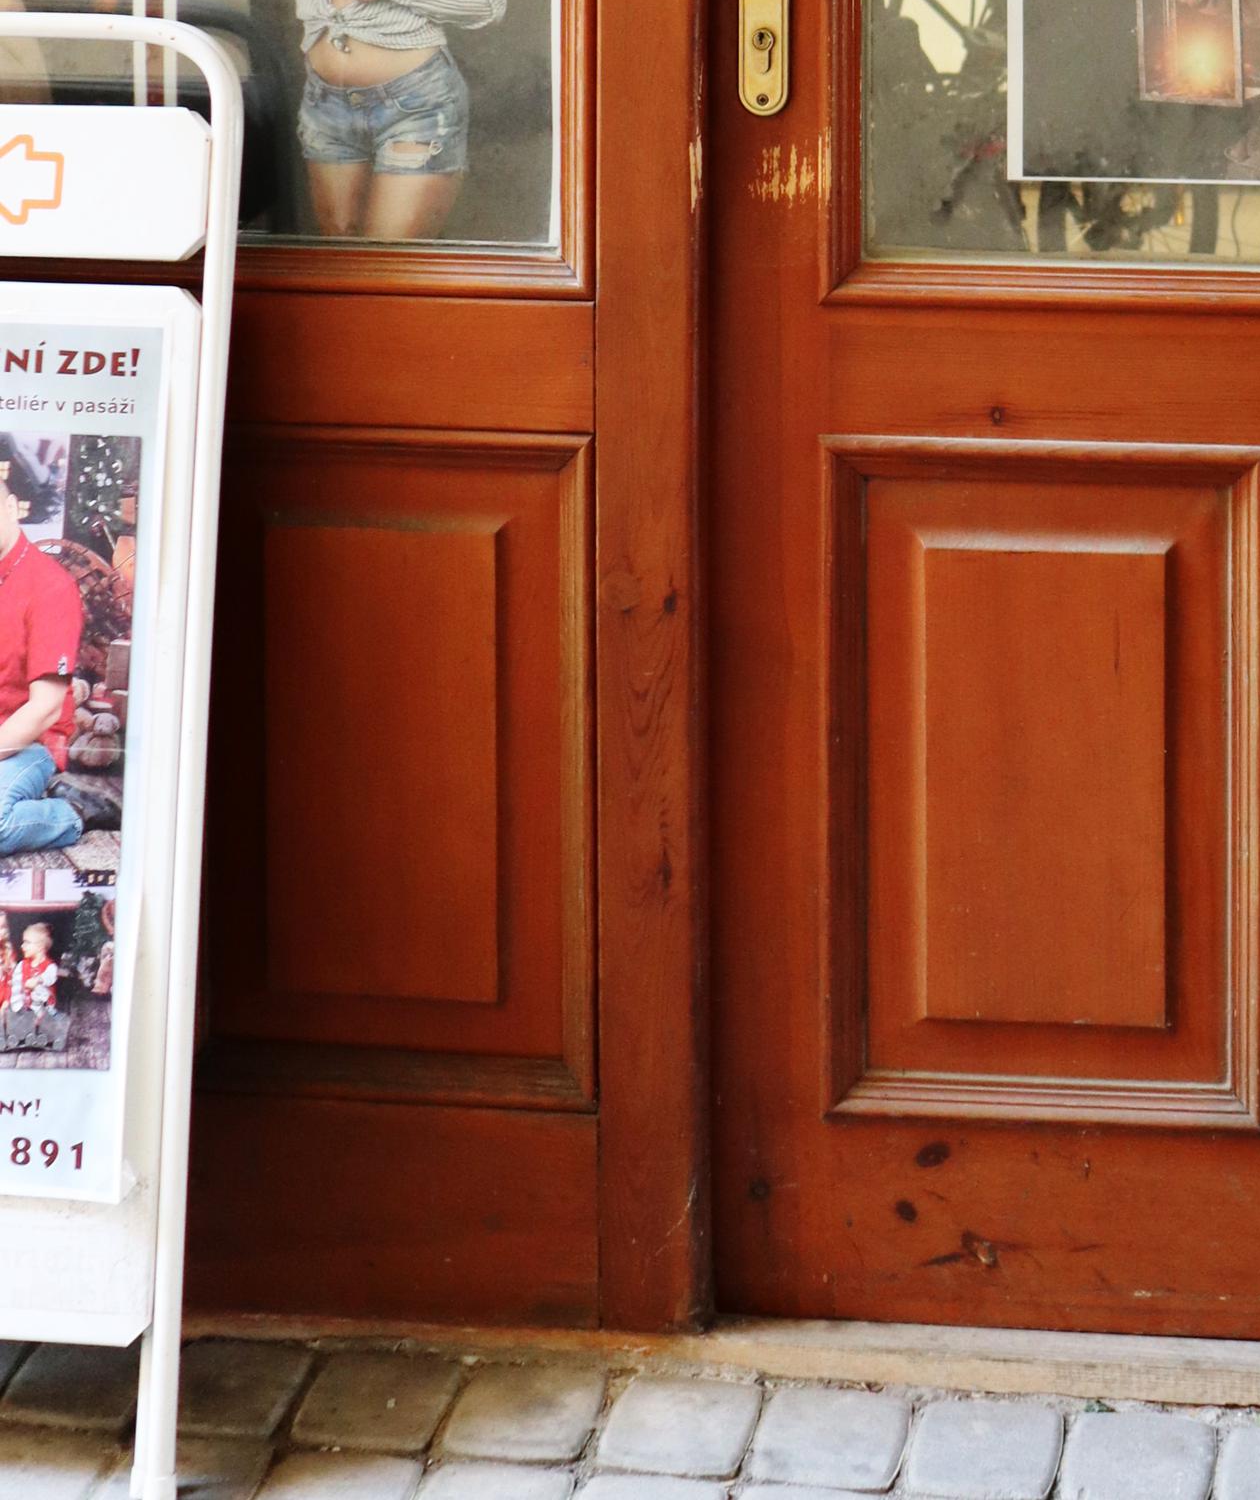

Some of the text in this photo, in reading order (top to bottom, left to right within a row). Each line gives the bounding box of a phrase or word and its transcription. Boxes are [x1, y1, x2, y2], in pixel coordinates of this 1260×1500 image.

[4, 341, 141, 377] NÍ ZDE!
[56, 400, 66, 411] v
[73, 397, 135, 416] pasáži
[10, 1136, 84, 1170] 891
